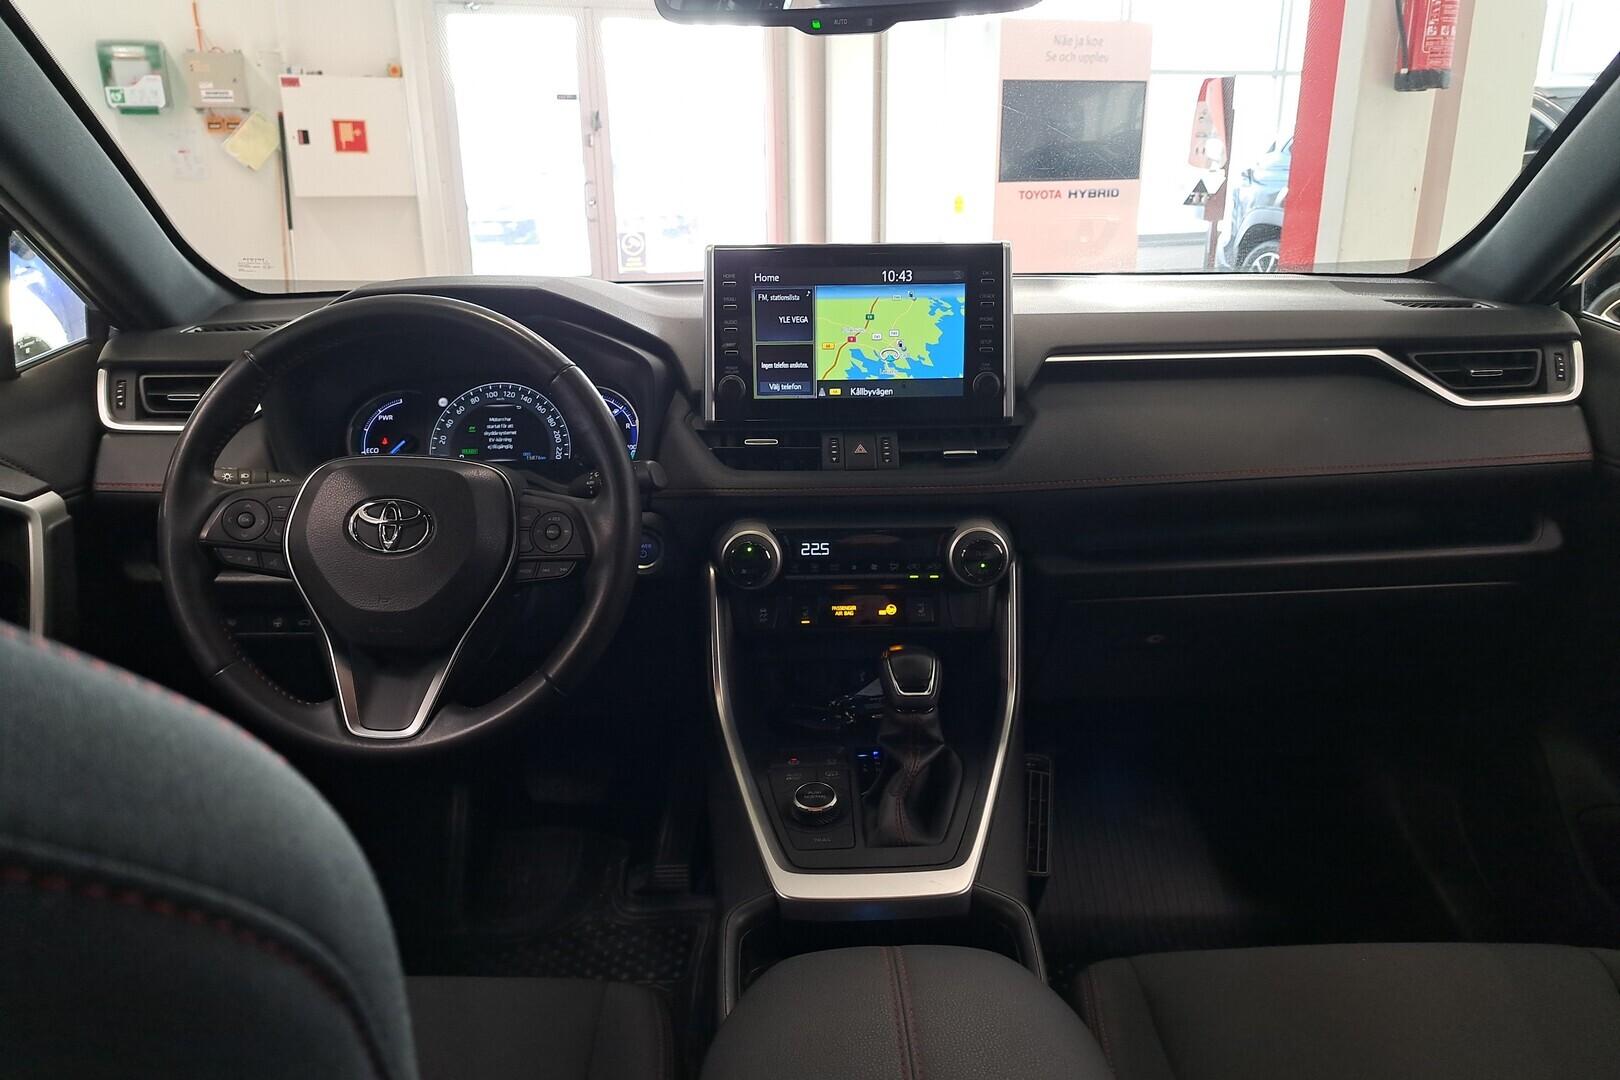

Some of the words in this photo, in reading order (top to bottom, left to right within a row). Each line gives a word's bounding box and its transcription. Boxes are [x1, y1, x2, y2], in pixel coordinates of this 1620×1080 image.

[1086, 35, 1104, 46] koe
[1045, 50, 1057, 62] Se
[1059, 51, 1076, 62] och
[1077, 50, 1110, 64] upplev
[1019, 189, 1061, 200] TOYOTA
[1068, 188, 1120, 199] HYBRID
[754, 272, 780, 282] Home
[881, 270, 913, 282] 10:43
[757, 294, 769, 302] FM,
[769, 383, 780, 391] Välj
[781, 382, 801, 390] telefon
[469, 395, 480, 405] 80
[485, 391, 499, 399] 100
[503, 391, 516, 399] 120
[520, 394, 533, 405] 140
[456, 405, 466, 416] 60
[534, 402, 547, 415] 160
[445, 418, 454, 430] 40
[546, 414, 557, 429] 180
[438, 434, 447, 446] 20
[553, 429, 562, 445] 200
[555, 446, 563, 461] 220
